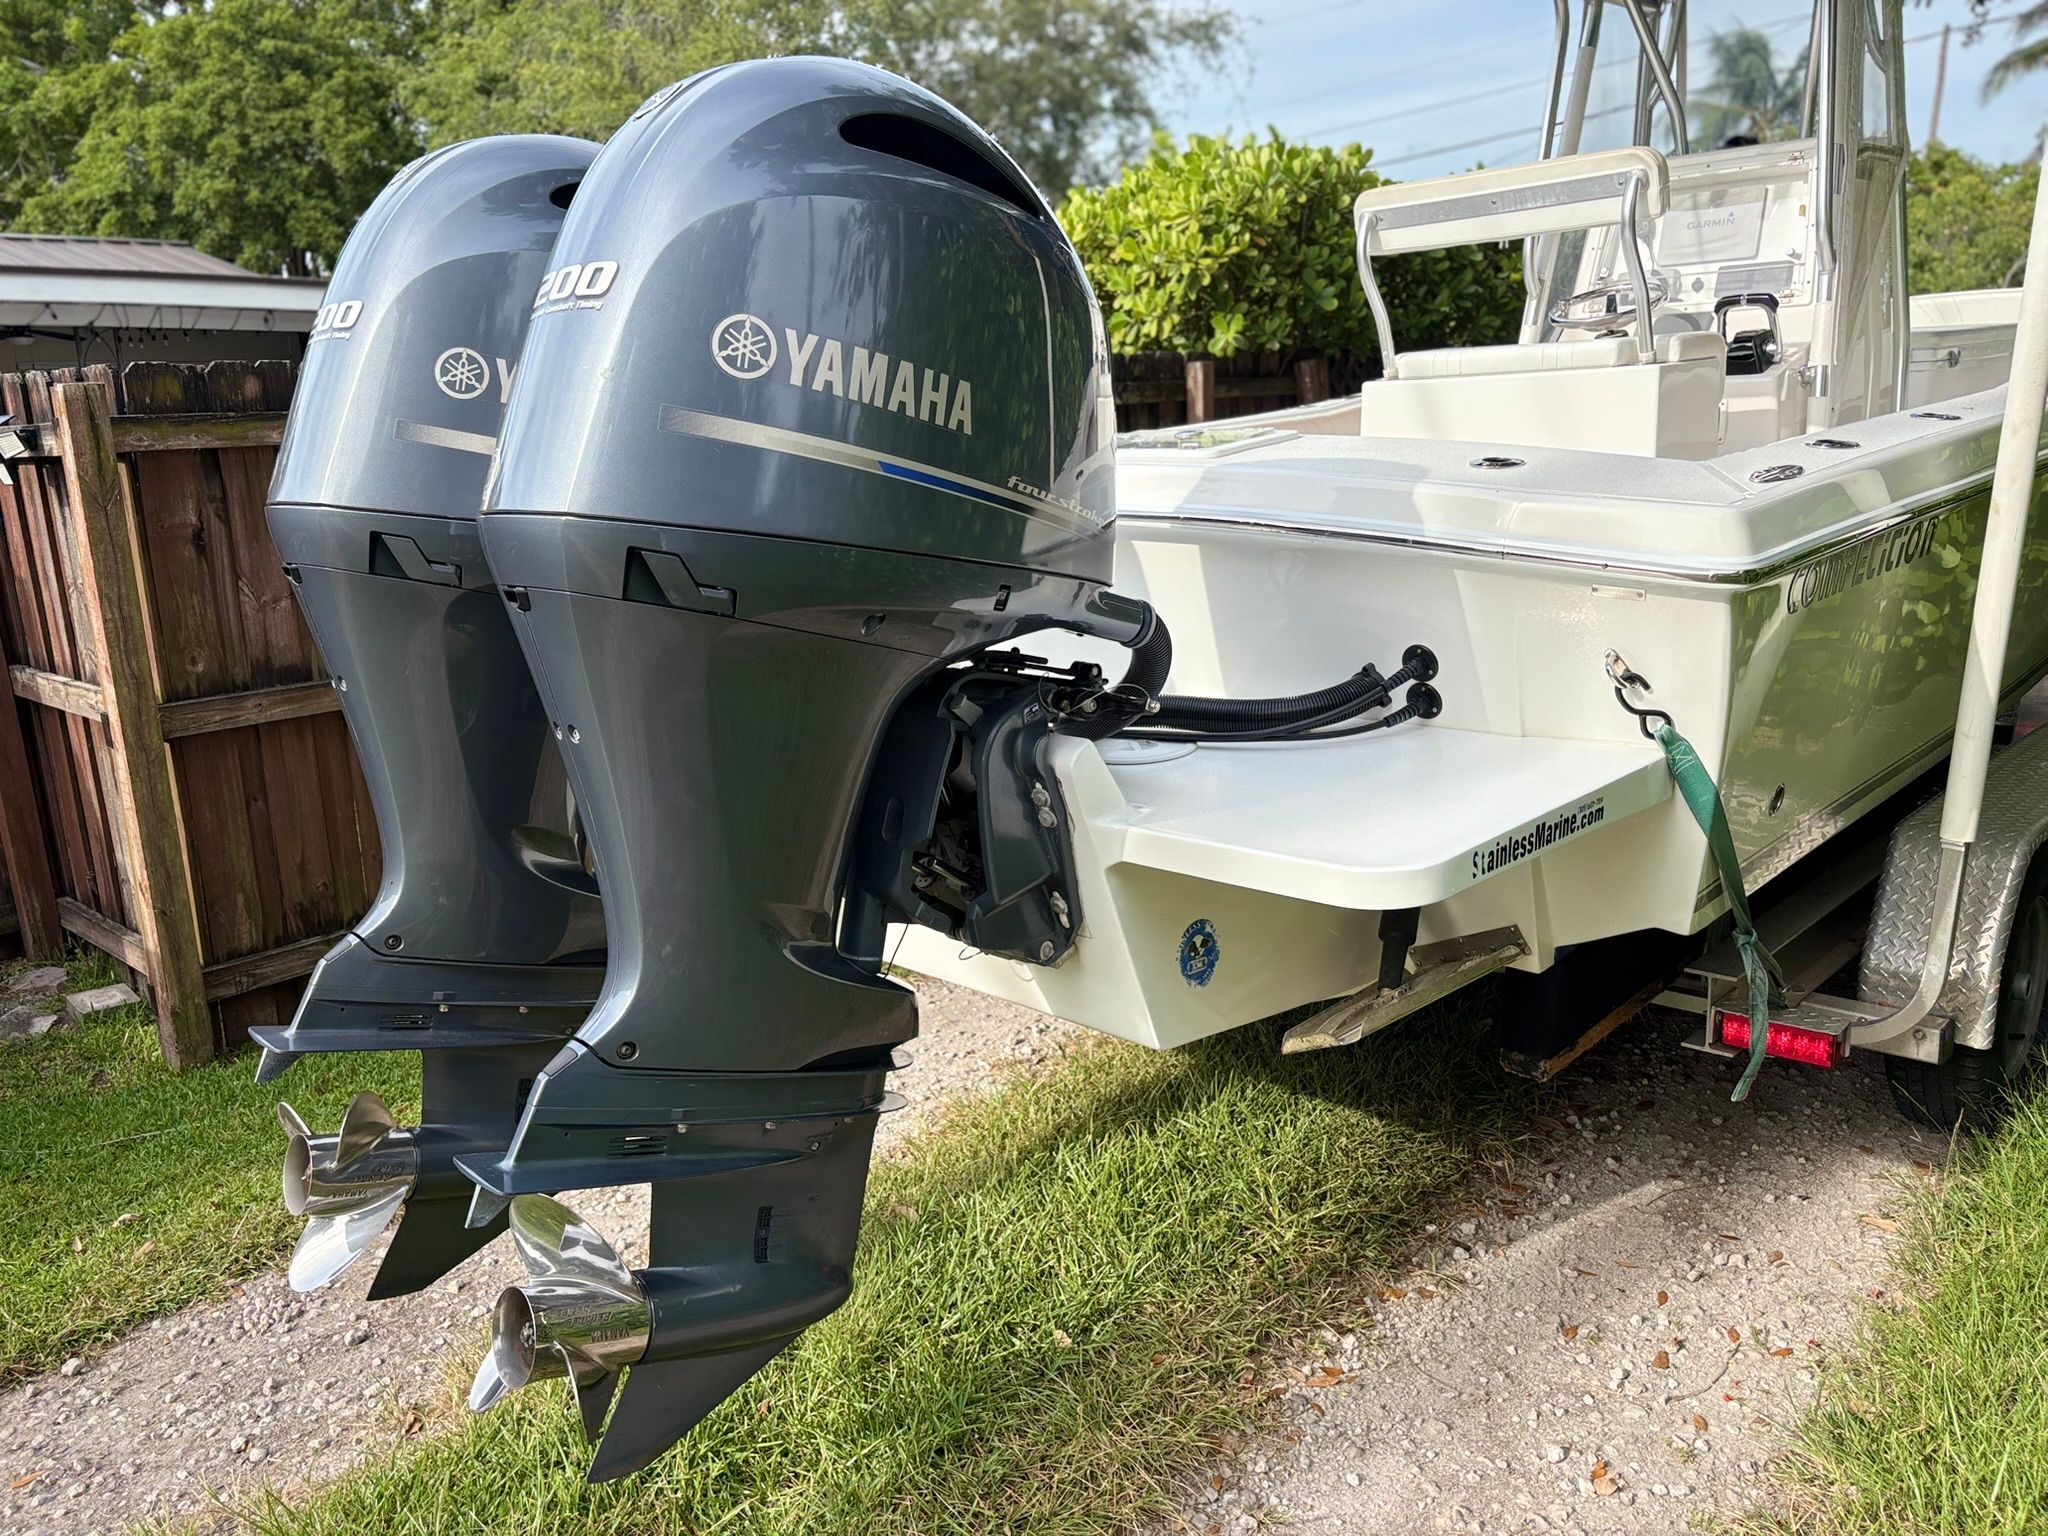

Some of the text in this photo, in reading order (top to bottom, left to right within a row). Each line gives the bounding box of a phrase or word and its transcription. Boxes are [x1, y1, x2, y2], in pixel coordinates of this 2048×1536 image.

[1686, 216, 1736, 230] GARMIN
[533, 260, 619, 310] 200
[785, 328, 973, 435] YAMAHA
[1472, 805, 1605, 879] StainlessMarine.com
[592, 1327, 631, 1343] YAMAHA
